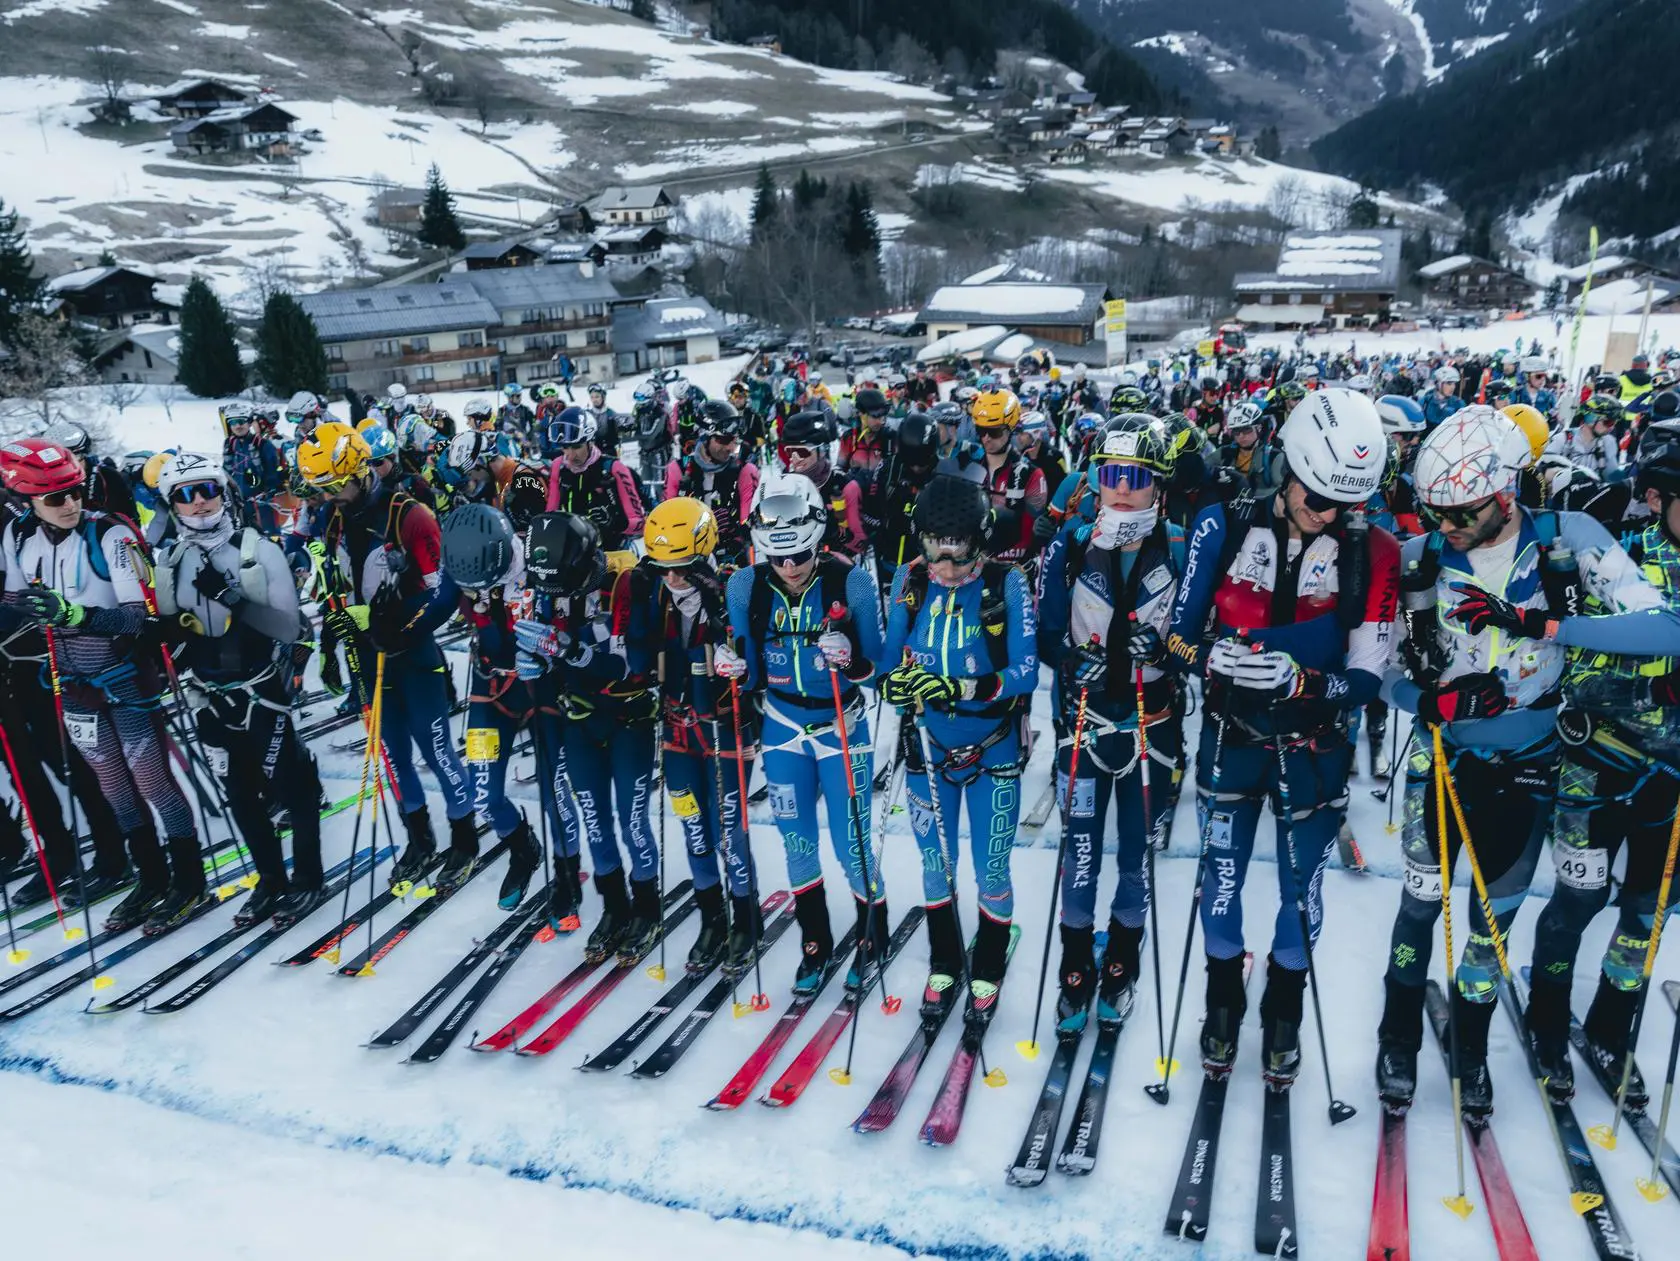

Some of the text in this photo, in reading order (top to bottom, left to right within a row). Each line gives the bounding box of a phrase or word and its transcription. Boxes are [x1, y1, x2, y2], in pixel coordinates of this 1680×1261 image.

[1320, 395, 1338, 429] ATOMIC
[1329, 472, 1374, 488] MÉRIBEL
[523, 524, 533, 559] ATOMIC
[1376, 564, 1400, 643] FRANCE
[267, 714, 286, 765] BLUE ICE
[576, 790, 603, 844] FRANCE
[1072, 833, 1089, 889] FRANCE
[1561, 859, 1606, 879] 49 B
[1212, 857, 1237, 916] FRANCE
[1024, 1132, 1047, 1170] TRAB
[1073, 1120, 1093, 1157] TRAB
[1189, 1139, 1209, 1185] DYNASTAR
[1270, 1153, 1284, 1202] DYNASTAR
